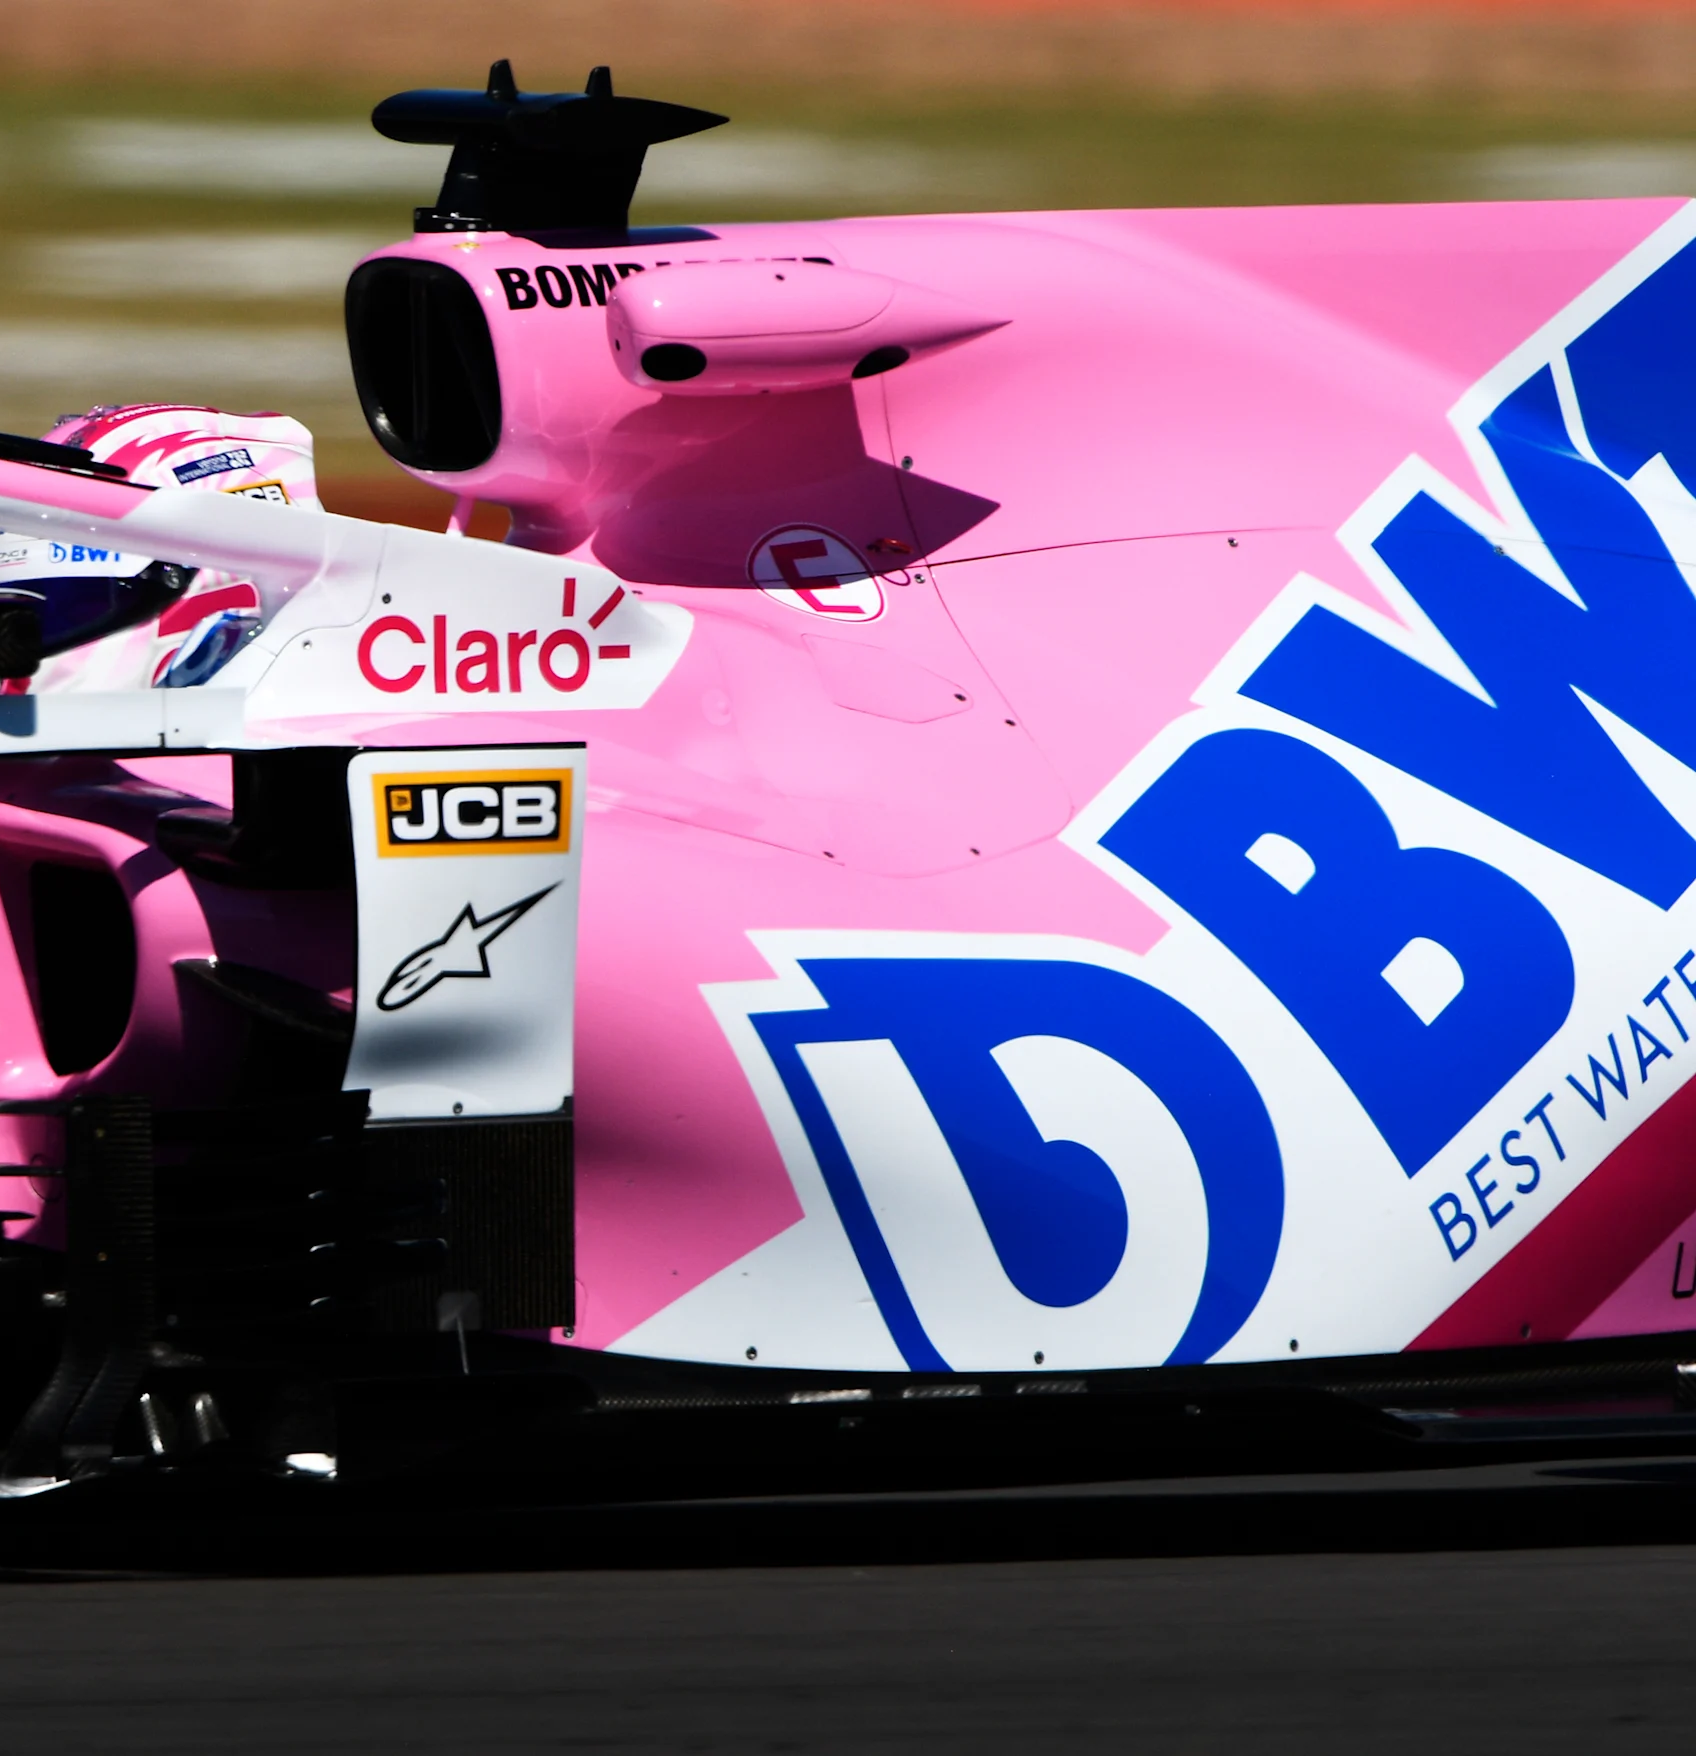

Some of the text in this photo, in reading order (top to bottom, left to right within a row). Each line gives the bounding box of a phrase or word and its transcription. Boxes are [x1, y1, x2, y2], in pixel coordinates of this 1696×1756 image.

[769, 538, 866, 614] E
[357, 613, 591, 693] Claro
[391, 786, 557, 840] JCB
[1428, 1093, 1566, 1262] BEST
